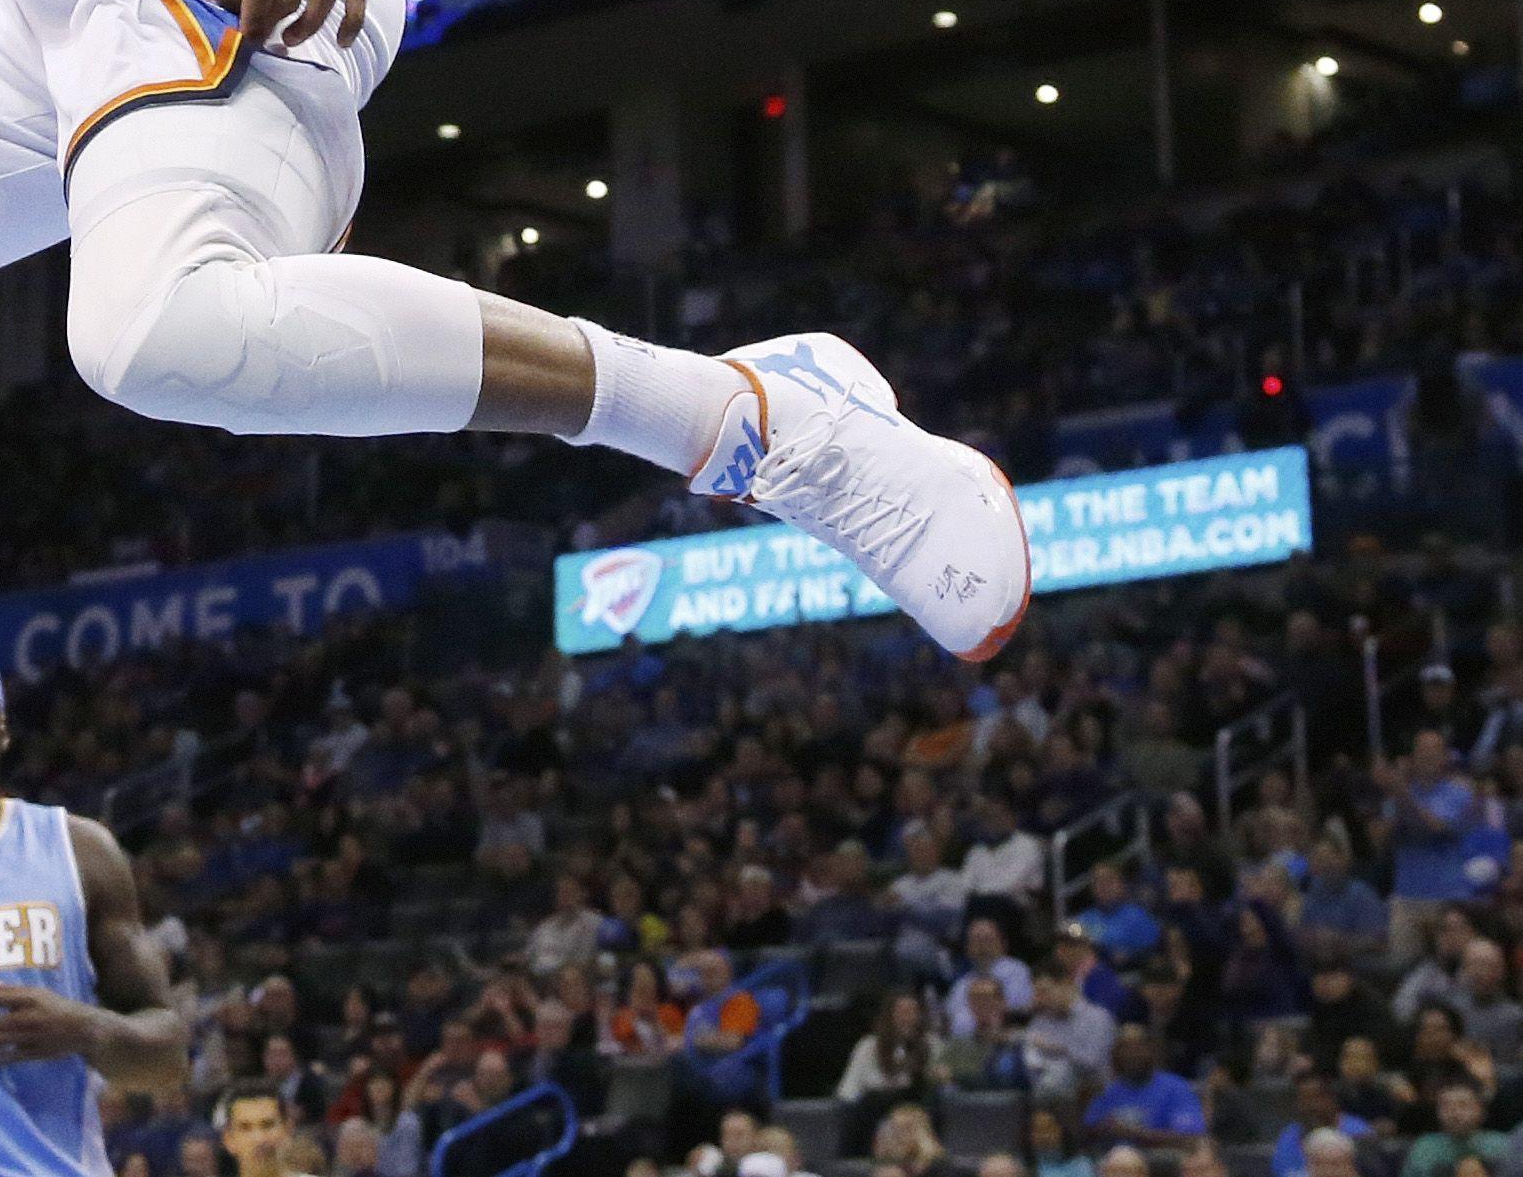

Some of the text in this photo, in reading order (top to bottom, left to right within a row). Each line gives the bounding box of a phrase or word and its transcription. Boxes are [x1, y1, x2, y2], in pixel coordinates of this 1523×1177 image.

[683, 542, 759, 584] BUY
[1065, 483, 1147, 526] THE
[1157, 465, 1278, 516] TEAM
[669, 586, 749, 628] AND
